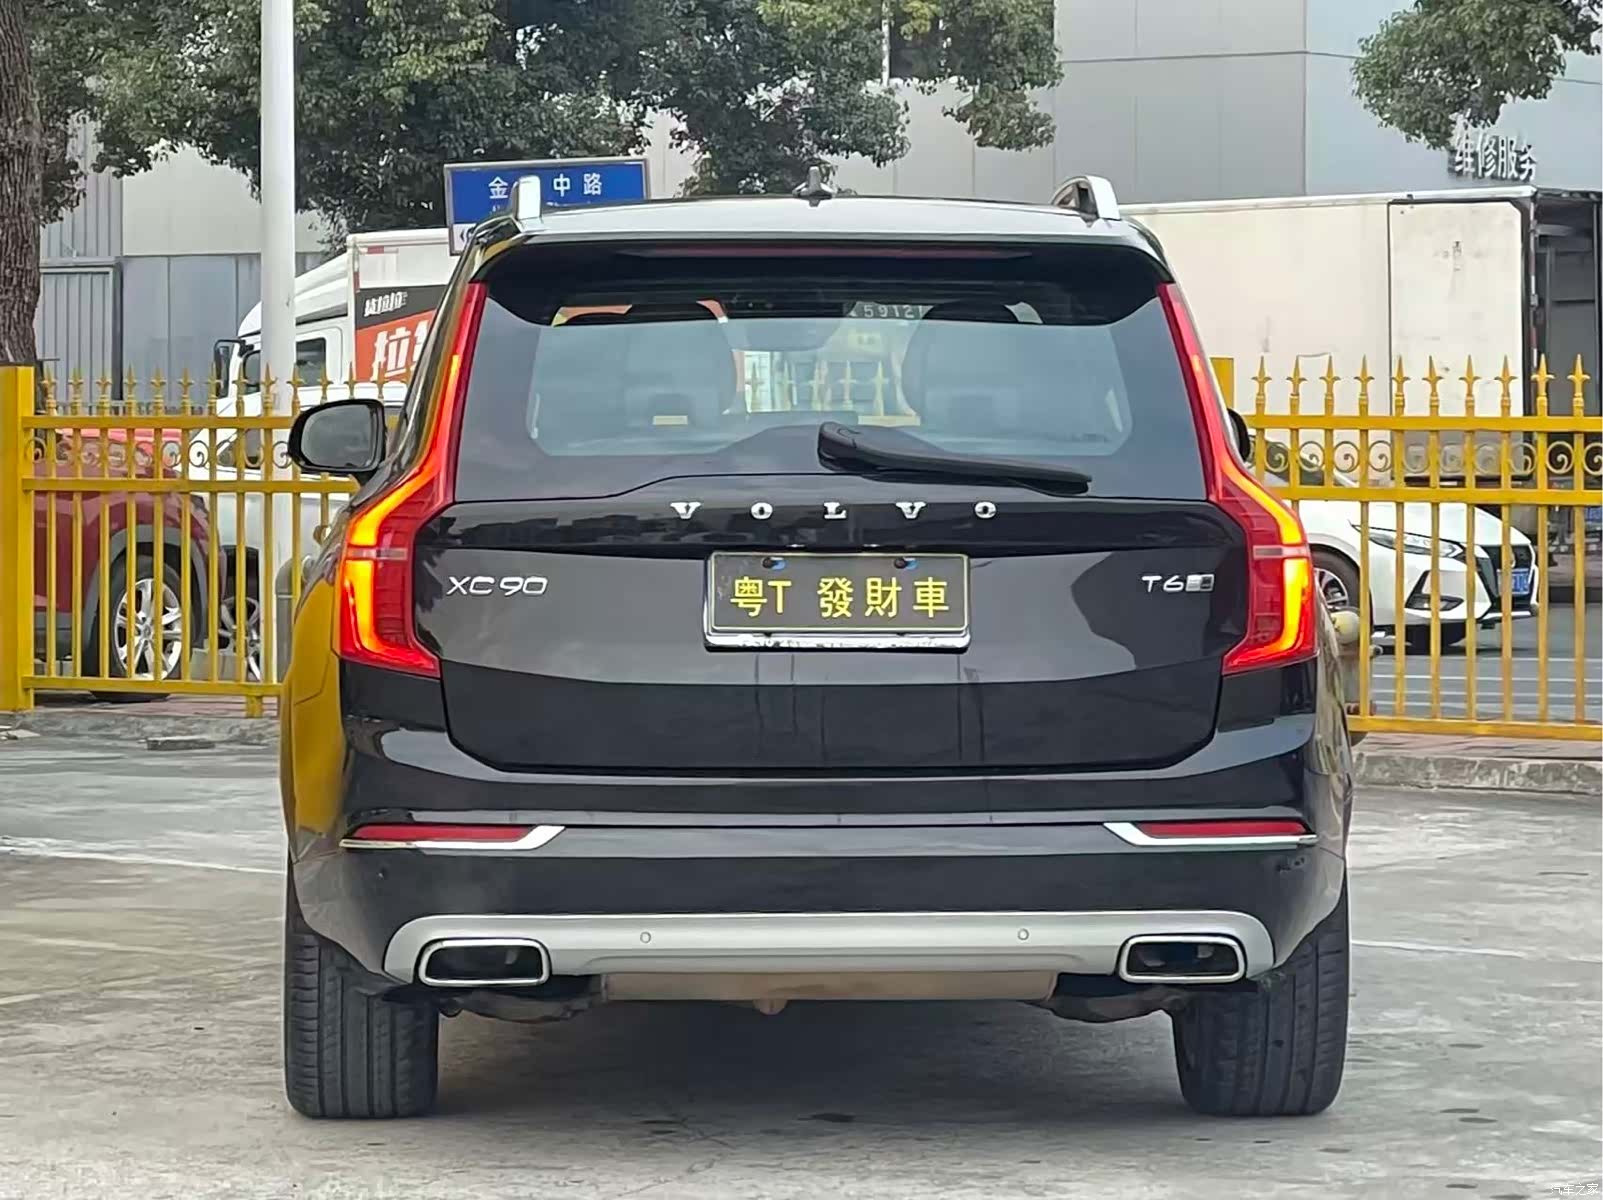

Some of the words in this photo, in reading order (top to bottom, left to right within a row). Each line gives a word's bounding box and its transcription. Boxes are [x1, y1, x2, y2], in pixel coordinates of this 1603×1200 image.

[488, 173, 603, 199] 金中路
[670, 501, 997, 519] VOLVO
[446, 576, 548, 596] XC90
[1141, 575, 1184, 592] T6
[730, 576, 792, 617] 粤T
[817, 576, 949, 618] 發財車
